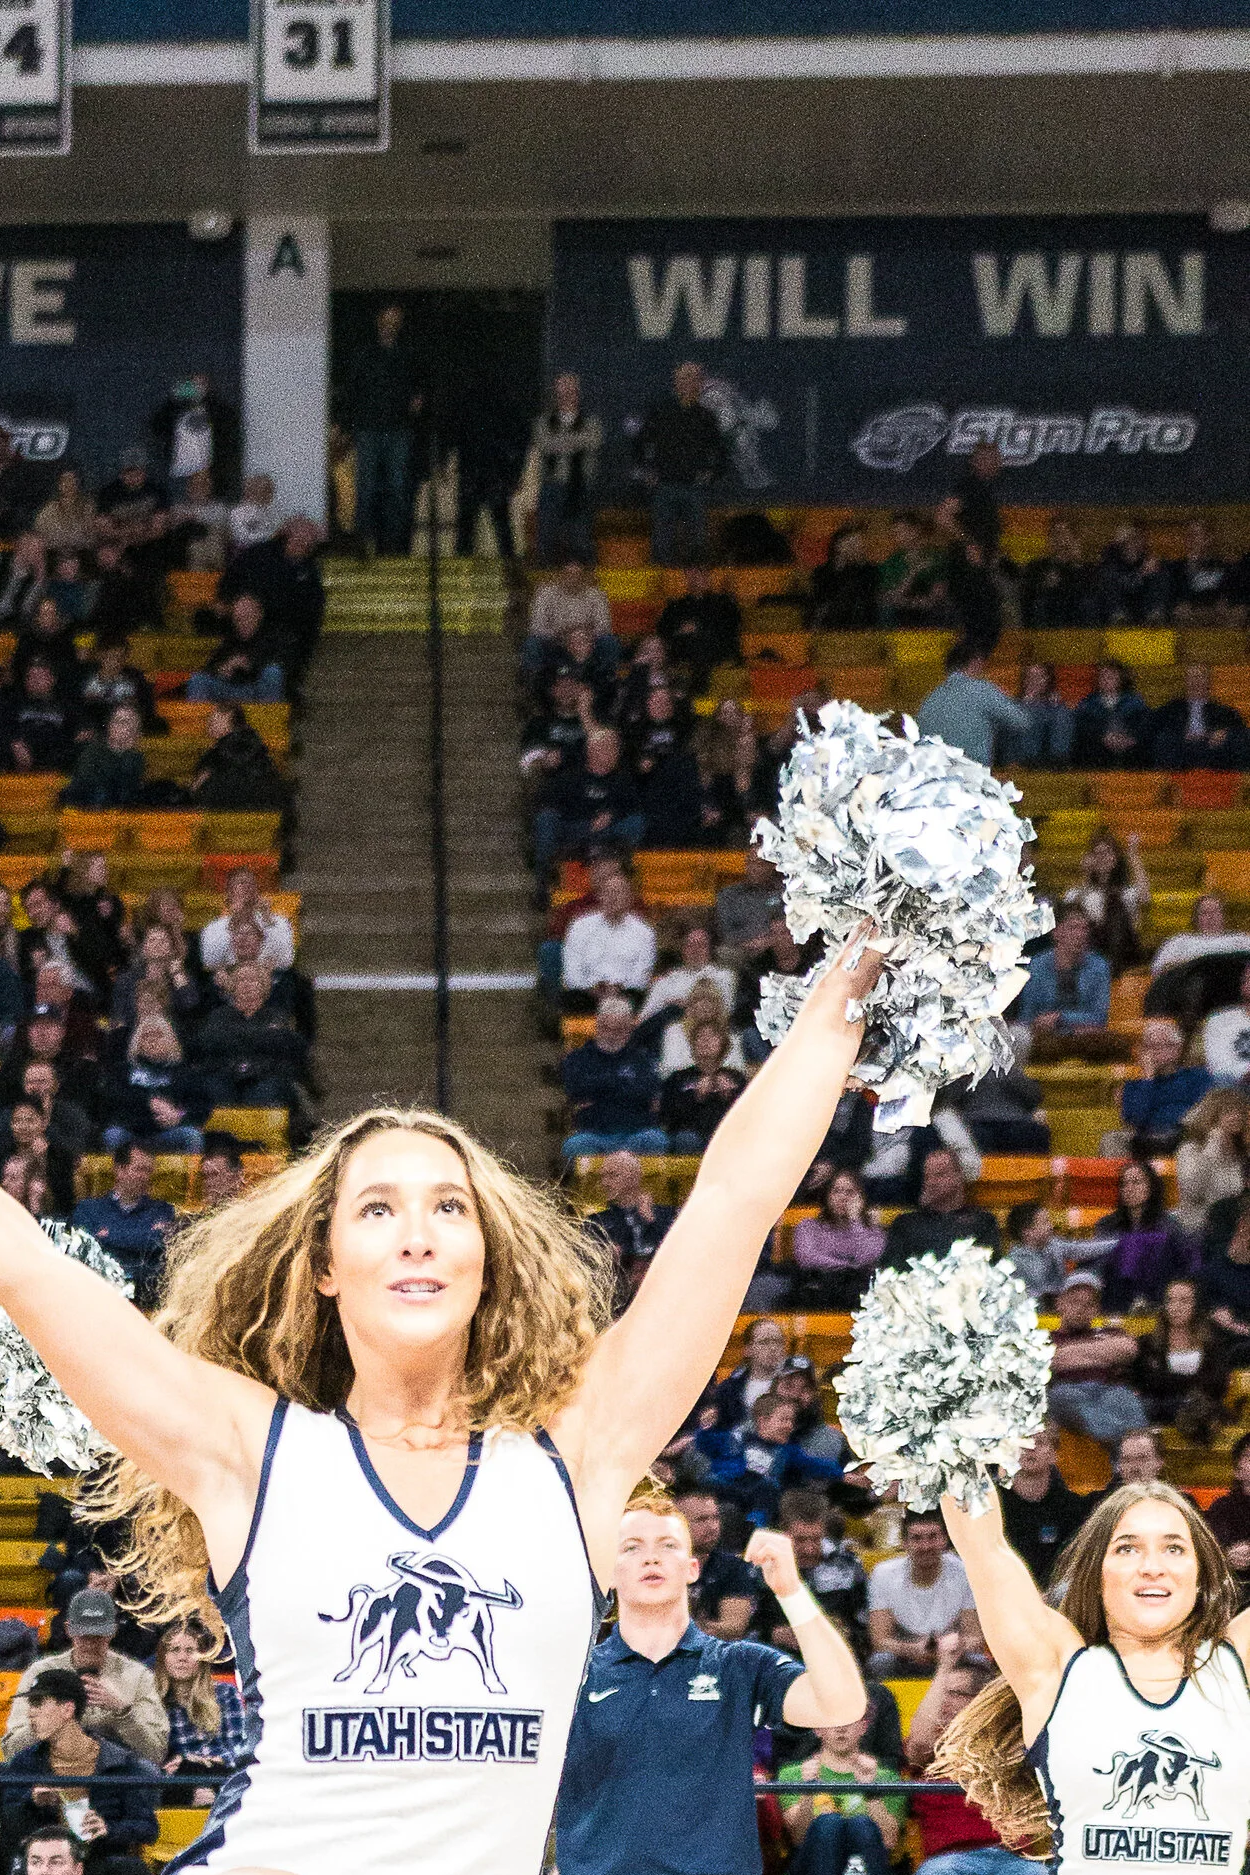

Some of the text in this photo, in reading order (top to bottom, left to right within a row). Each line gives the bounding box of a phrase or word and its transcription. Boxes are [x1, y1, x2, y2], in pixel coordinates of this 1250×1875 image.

[283, 19, 355, 70] 31
[268, 231, 305, 277] A
[627, 250, 1206, 340] WILL WIN
[303, 1706, 544, 1763] UTAH STATE
[1083, 1824, 1233, 1866] UTAH STATE
